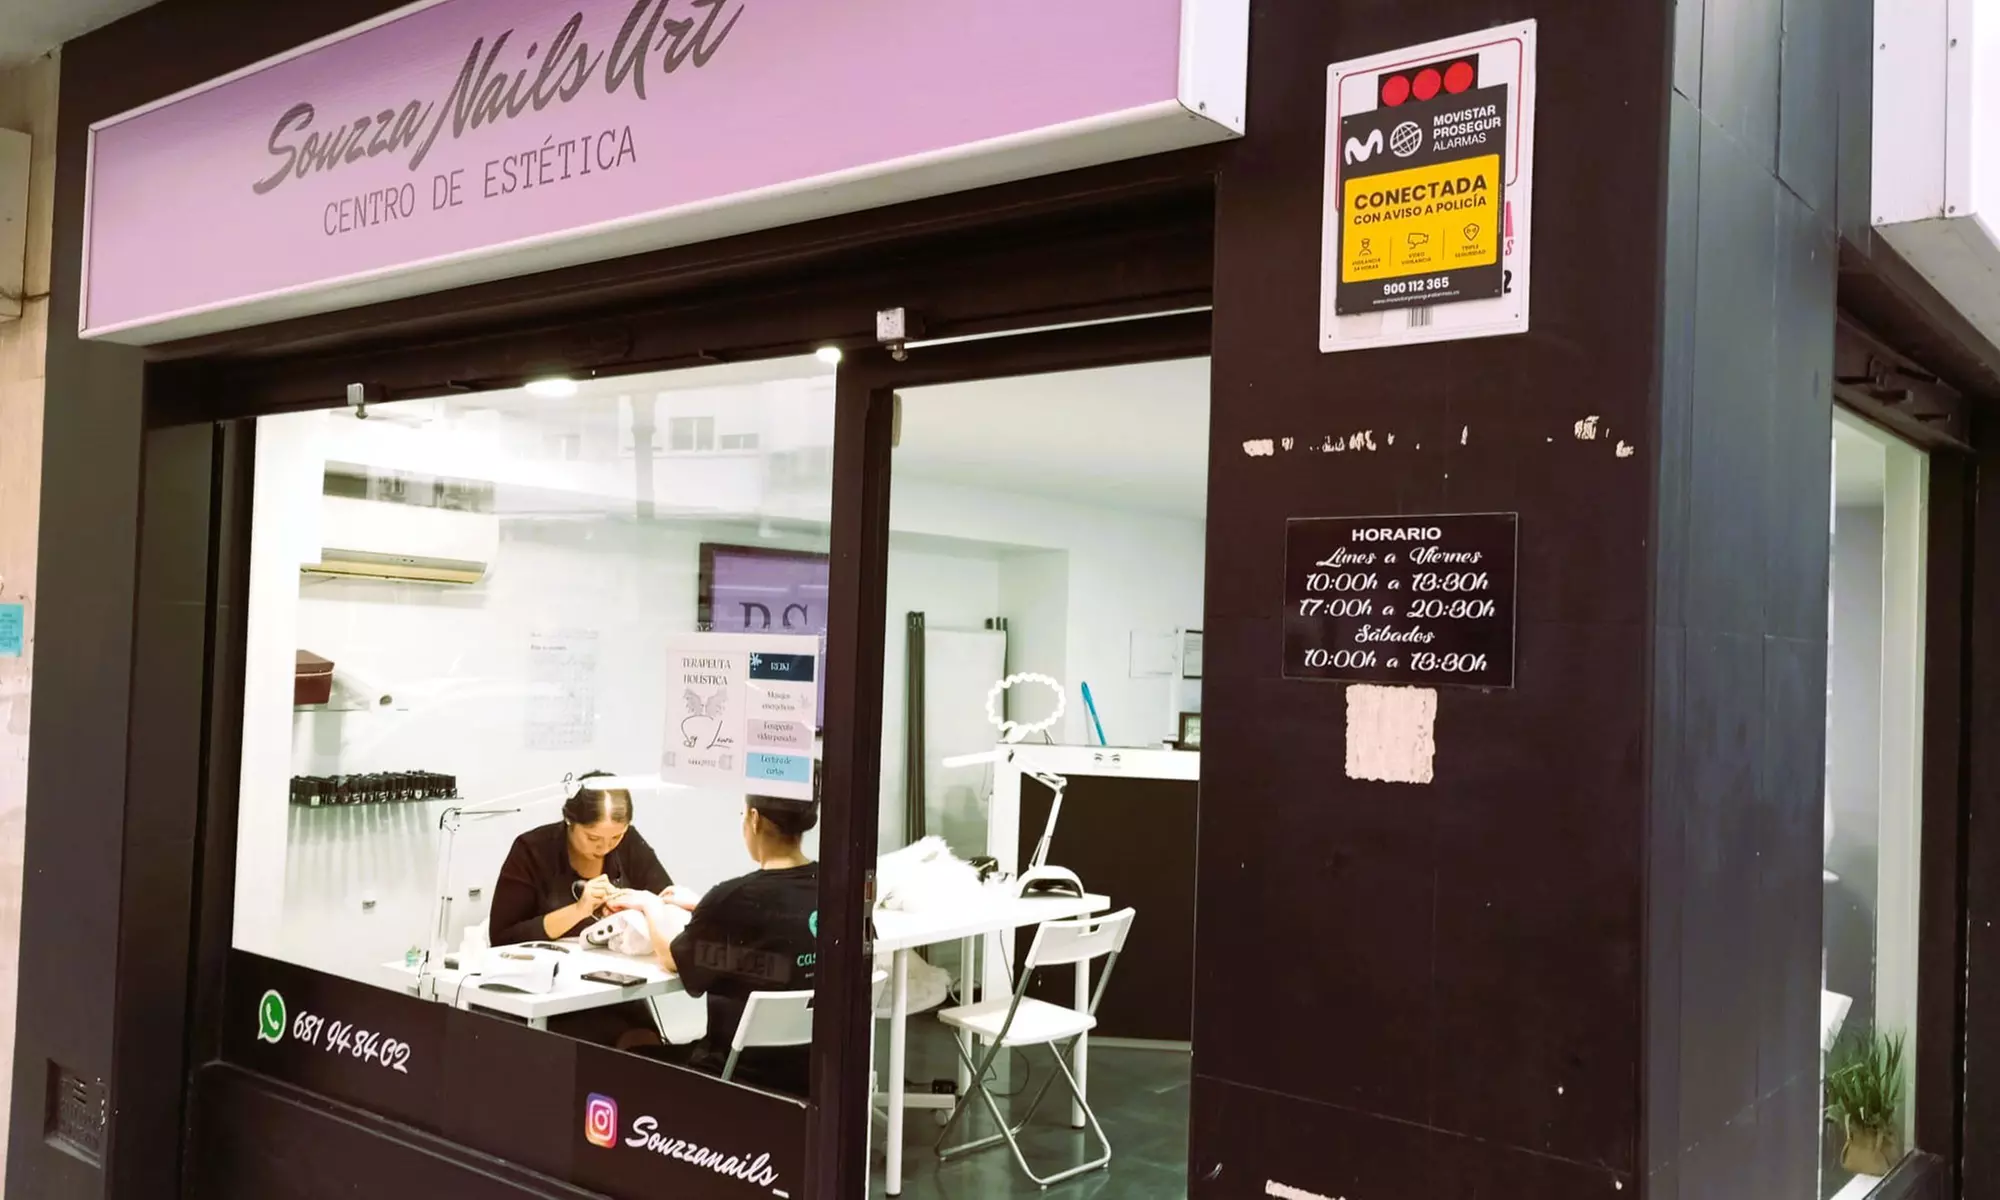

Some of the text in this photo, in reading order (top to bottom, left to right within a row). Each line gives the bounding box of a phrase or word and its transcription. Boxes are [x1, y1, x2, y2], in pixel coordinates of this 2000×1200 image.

[252, 0, 745, 195] Souzza Nails Art
[1433, 104, 1496, 127] MOVISTAR
[1433, 116, 1501, 139] PROSEGUR
[1433, 132, 1487, 152] ALARMAS
[323, 125, 636, 236] CENTRO DE ESTÉTICA
[1354, 174, 1487, 210] CONECTADA
[1354, 194, 1487, 225] CON AVISO A POLICÍA
[1383, 276, 1450, 295] 900 112 365
[1351, 527, 1442, 541] HORARIO
[1316, 546, 1483, 568] Lunes a Viernes
[1306, 572, 1379, 592] 10:00h
[1387, 579, 1400, 590] a
[1300, 598, 1373, 617] 17:00h
[1382, 604, 1395, 616] a
[1354, 623, 1435, 644] Sábados
[682, 657, 731, 669] TERAPEUTA
[1304, 648, 1378, 668] 10:00h
[1386, 657, 1400, 668] a
[293, 1011, 325, 1046] 681
